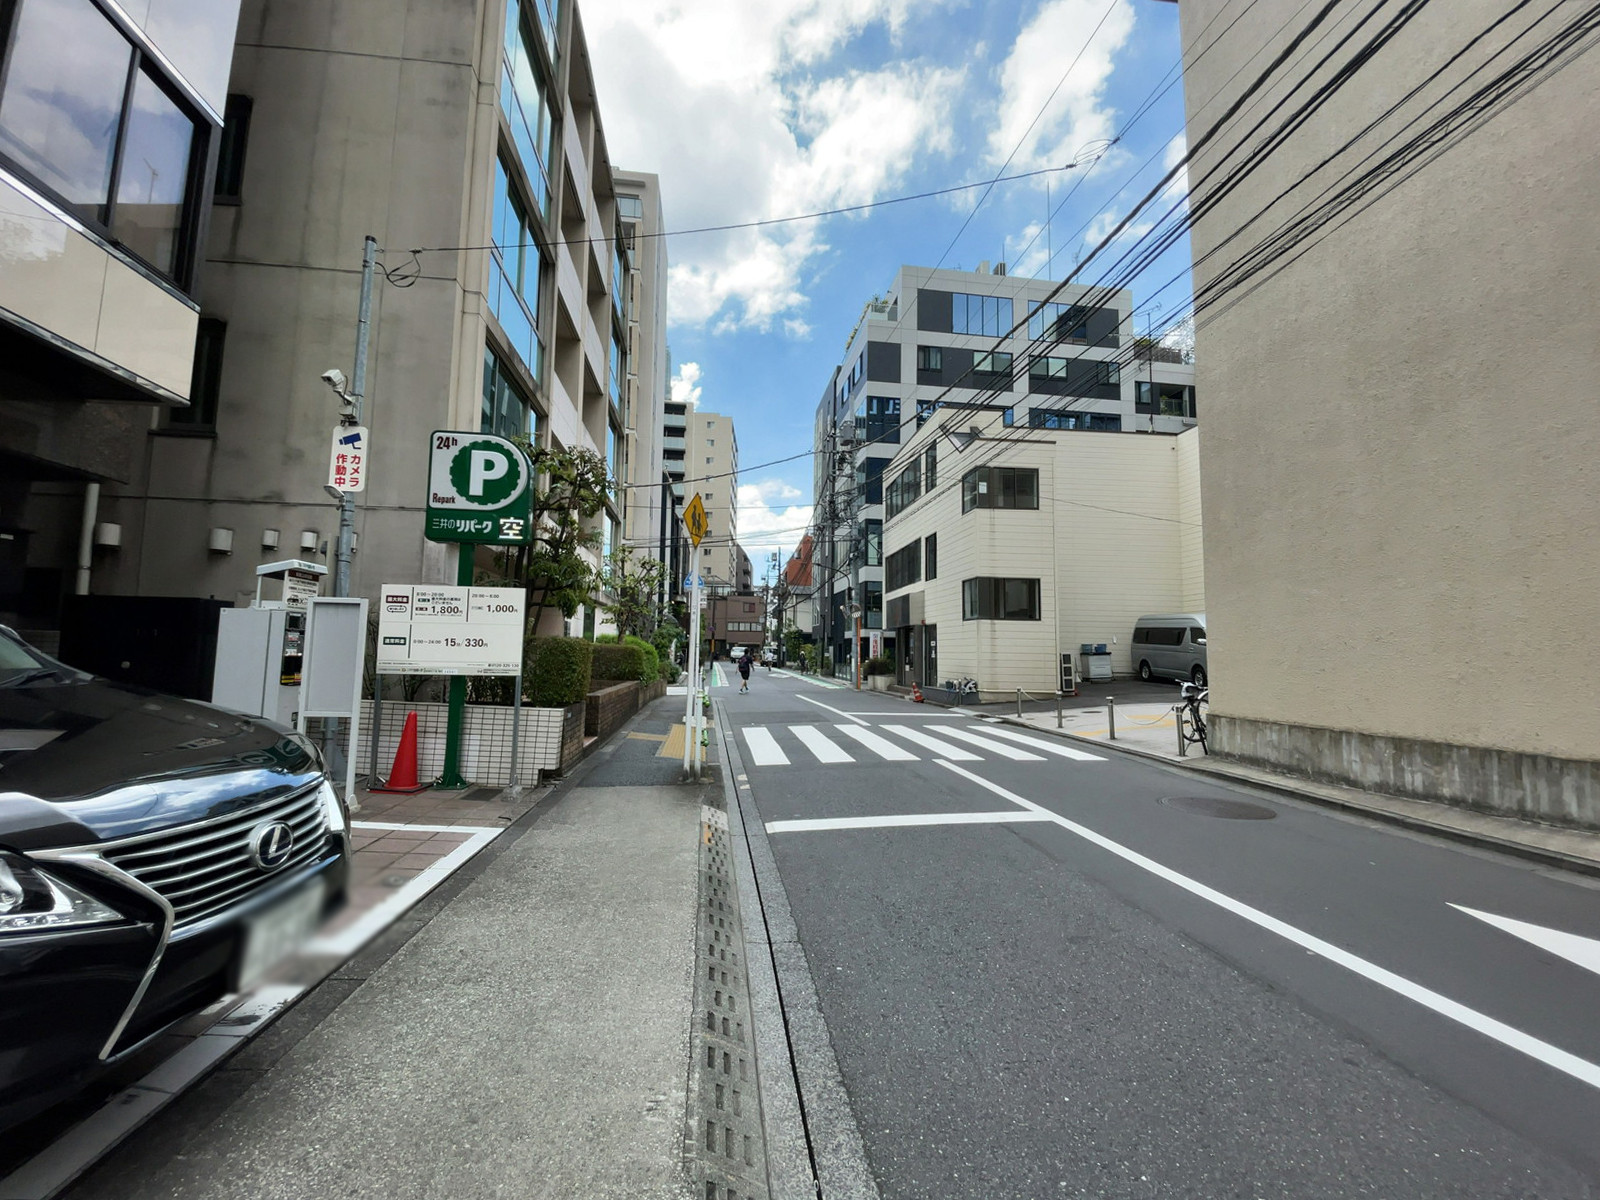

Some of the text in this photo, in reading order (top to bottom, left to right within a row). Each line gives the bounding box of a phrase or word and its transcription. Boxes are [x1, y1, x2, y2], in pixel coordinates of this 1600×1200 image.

[436, 436, 458, 450] 24h
[334, 453, 348, 488] 作動中
[349, 454, 362, 488] カメラ
[468, 449, 509, 497] P
[432, 493, 456, 505] Repark
[432, 518, 493, 534] 三井のリパーク
[498, 516, 524, 540] 空
